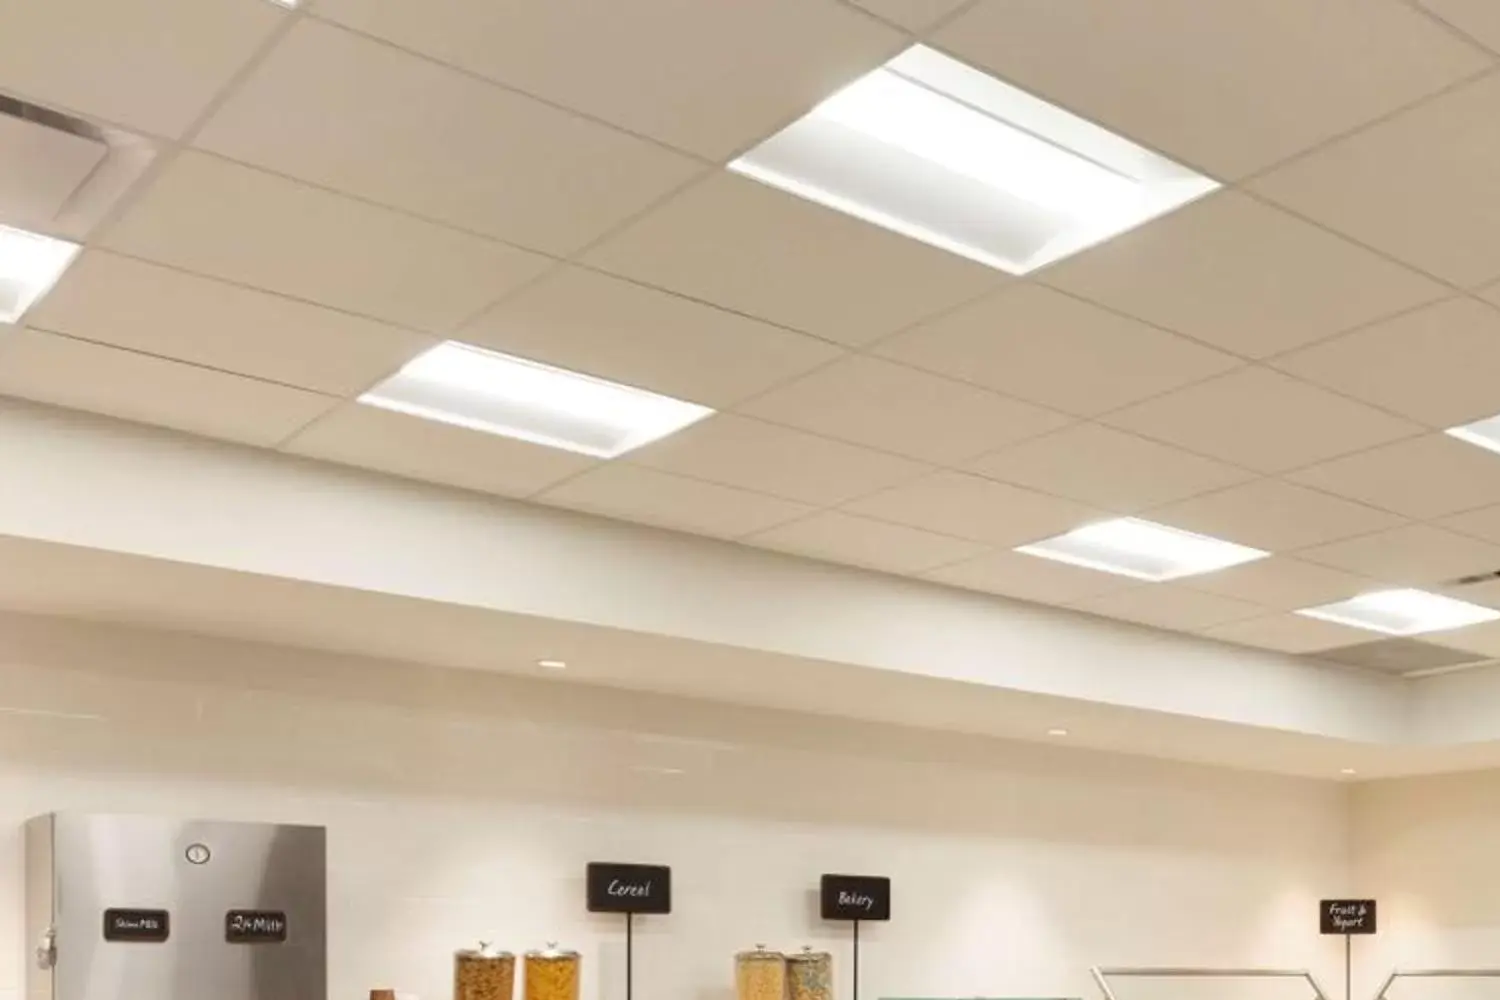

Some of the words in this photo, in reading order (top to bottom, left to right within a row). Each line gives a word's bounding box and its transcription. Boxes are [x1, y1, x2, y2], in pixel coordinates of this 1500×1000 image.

[607, 879, 652, 897] Cereal
[838, 890, 874, 911] Bakery
[1329, 903, 1356, 915] Fruit
